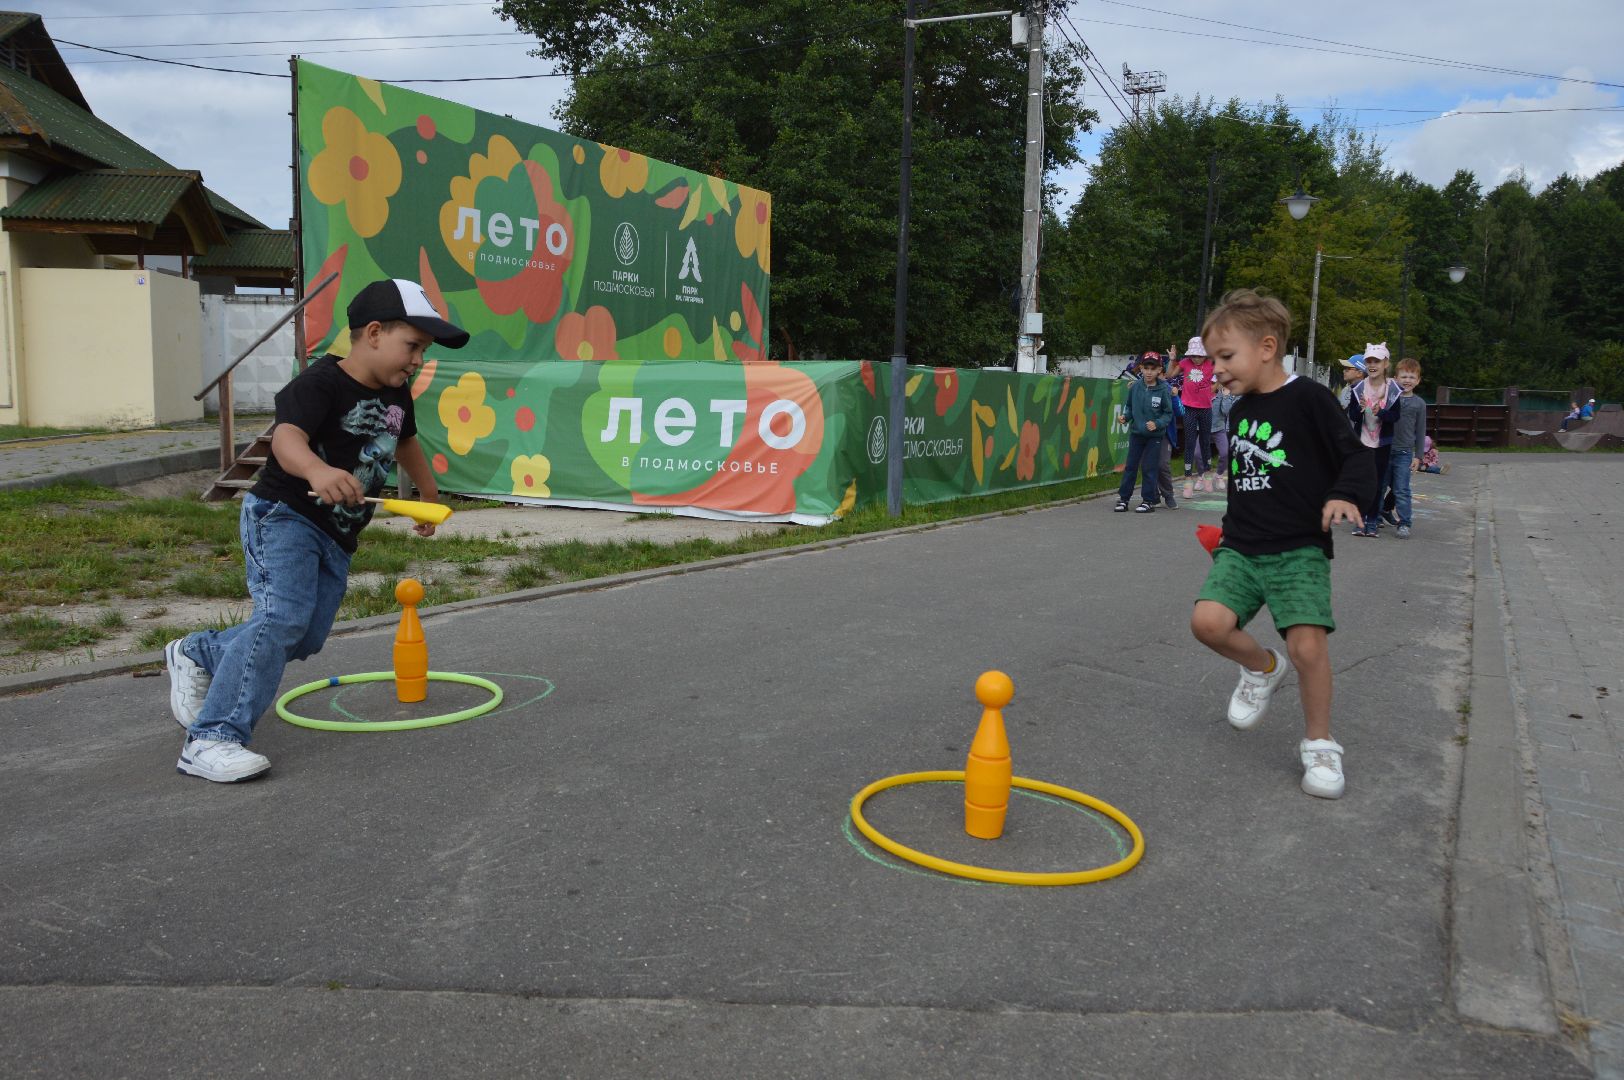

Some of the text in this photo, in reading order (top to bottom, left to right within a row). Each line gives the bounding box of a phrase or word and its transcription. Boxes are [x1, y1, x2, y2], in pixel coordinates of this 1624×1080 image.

[480, 252, 556, 271] ПОДМОСКОВЬЕ
[612, 270, 639, 283] ПАРКИ
[593, 280, 655, 298] ПОДМОСКОВЬЯ
[682, 285, 698, 295] ПАРК
[903, 416, 925, 435] РКИ
[903, 438, 964, 459] ДМОСКОВЬЯ
[622, 456, 778, 474] В ПОДМОСКОВЬЕ
[1234, 475, 1272, 492] T-REX
